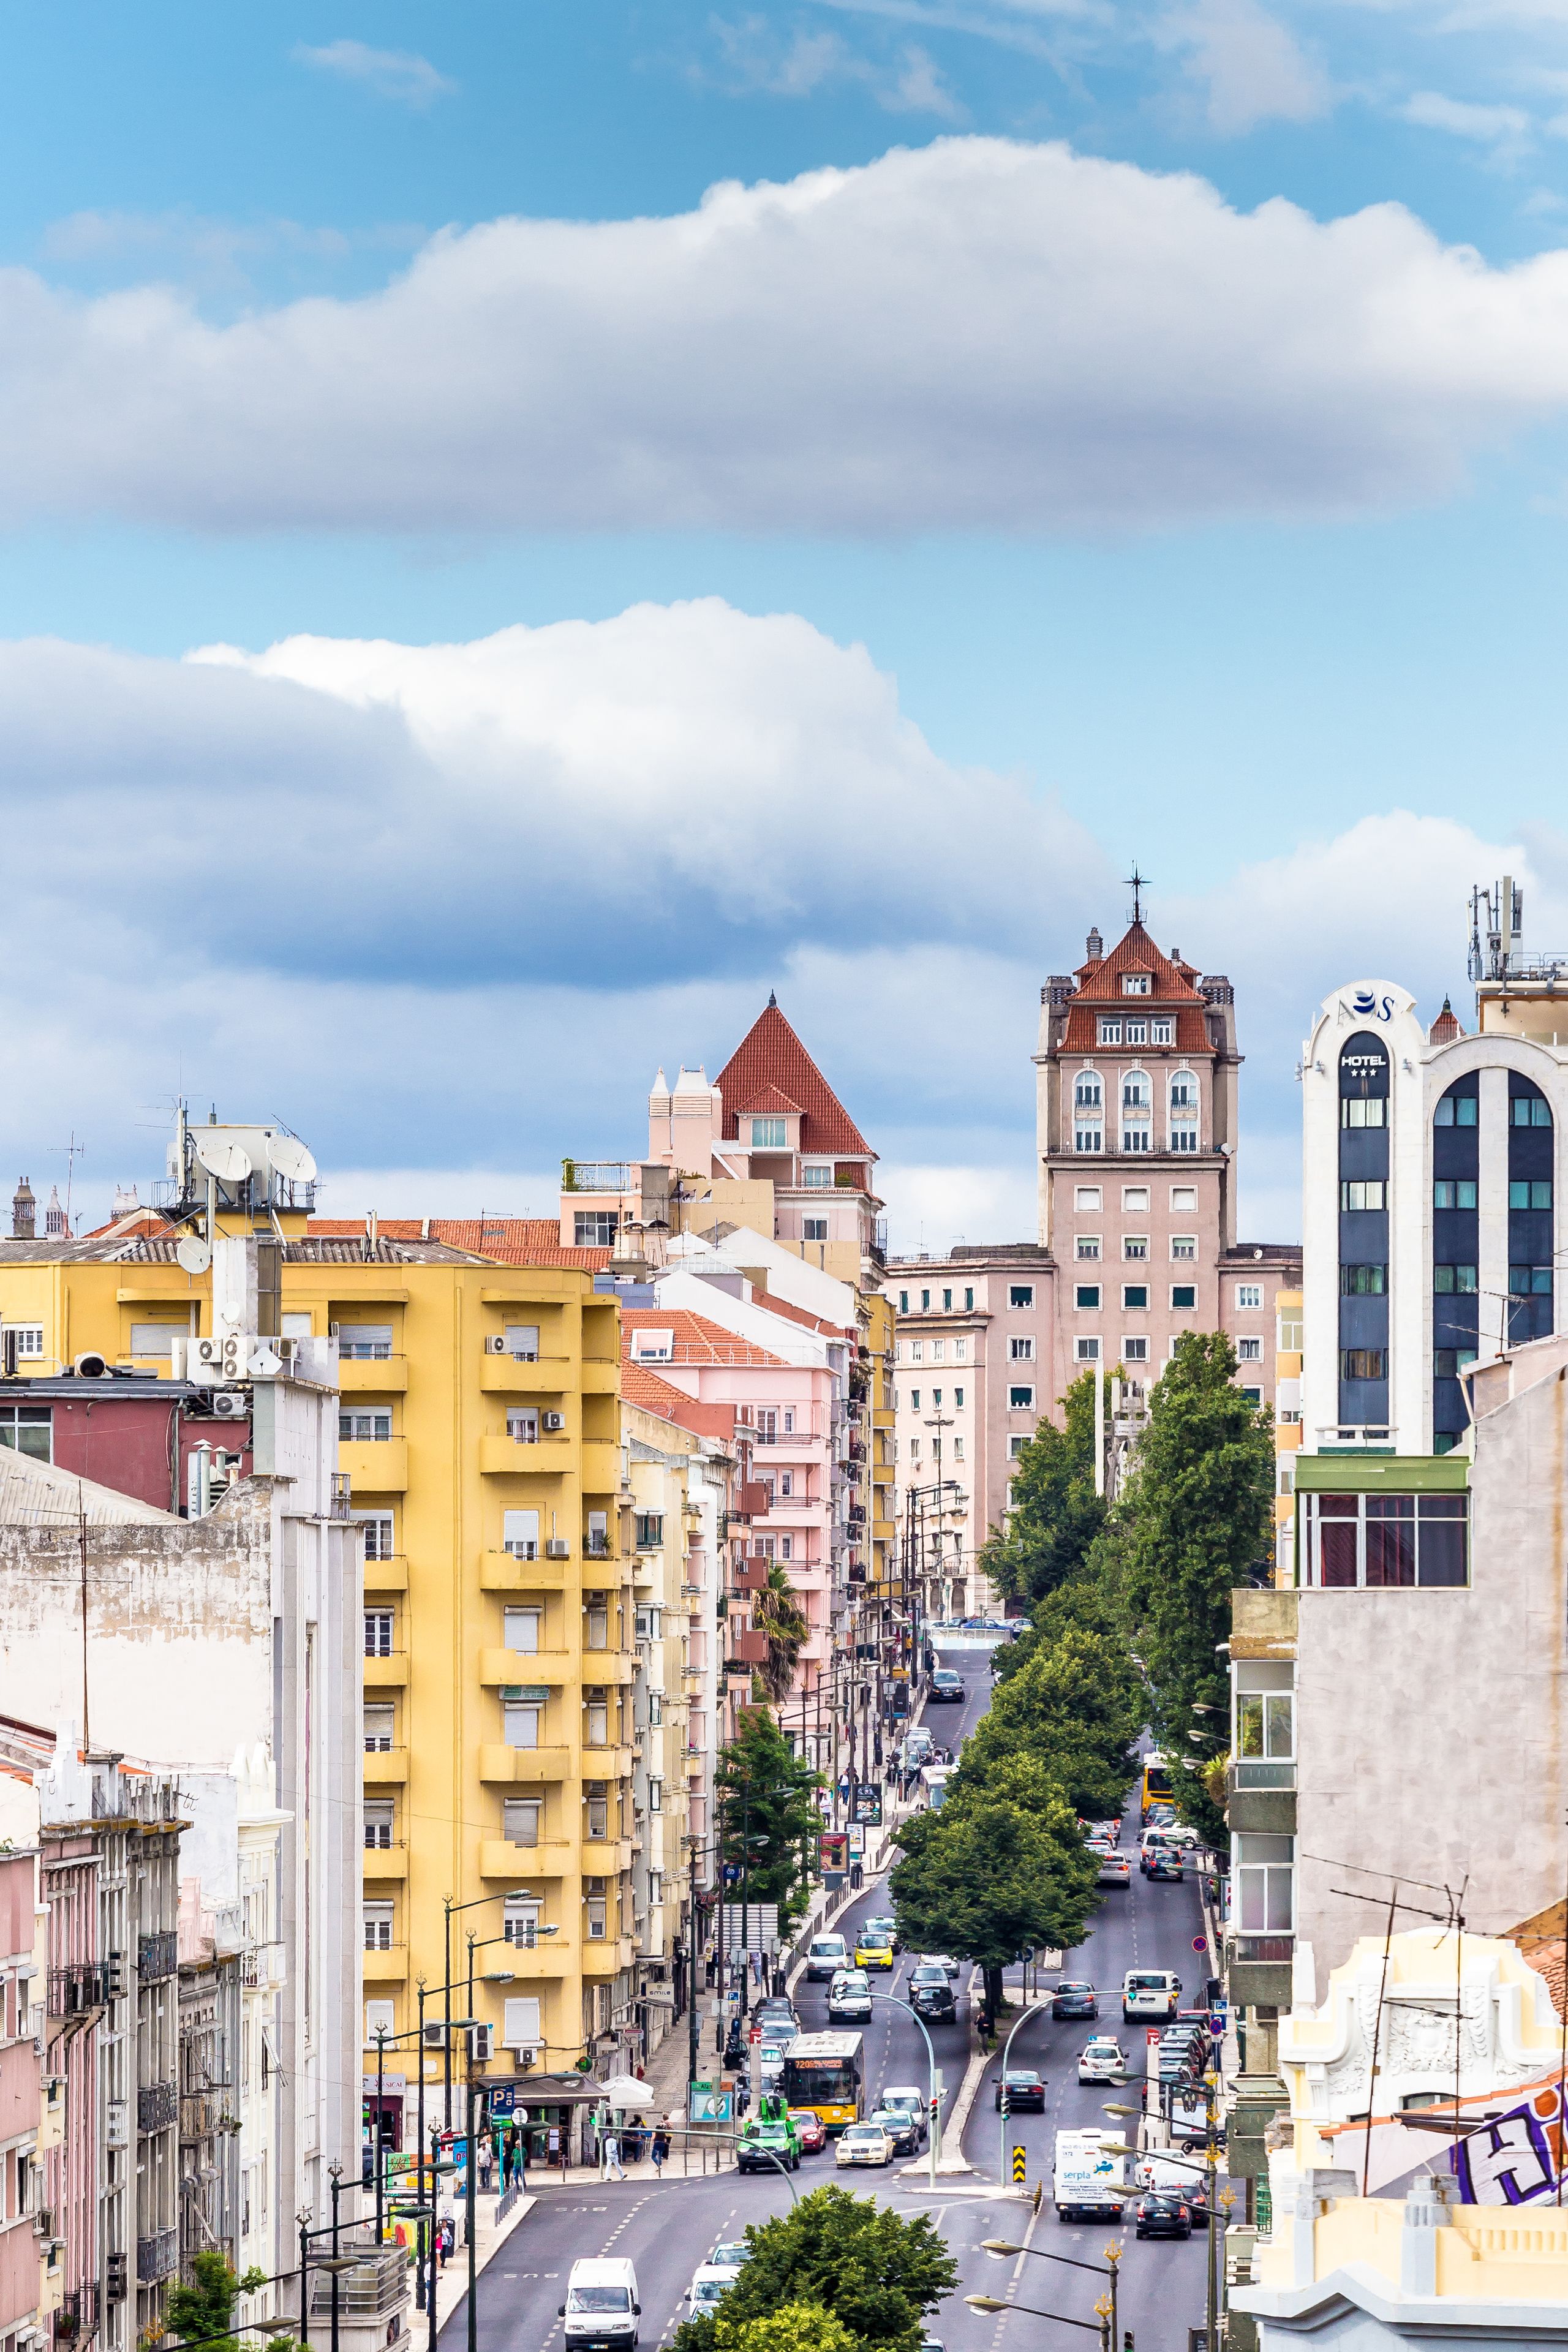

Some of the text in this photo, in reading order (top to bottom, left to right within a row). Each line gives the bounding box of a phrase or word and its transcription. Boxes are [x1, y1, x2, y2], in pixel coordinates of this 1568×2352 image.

[1341, 1055, 1386, 1066] HOTEL
[620, 2036, 638, 2045] LXC
[795, 2060, 810, 2068] 720
[493, 2090, 505, 2106] P
[1063, 2171, 1091, 2180] serpla
